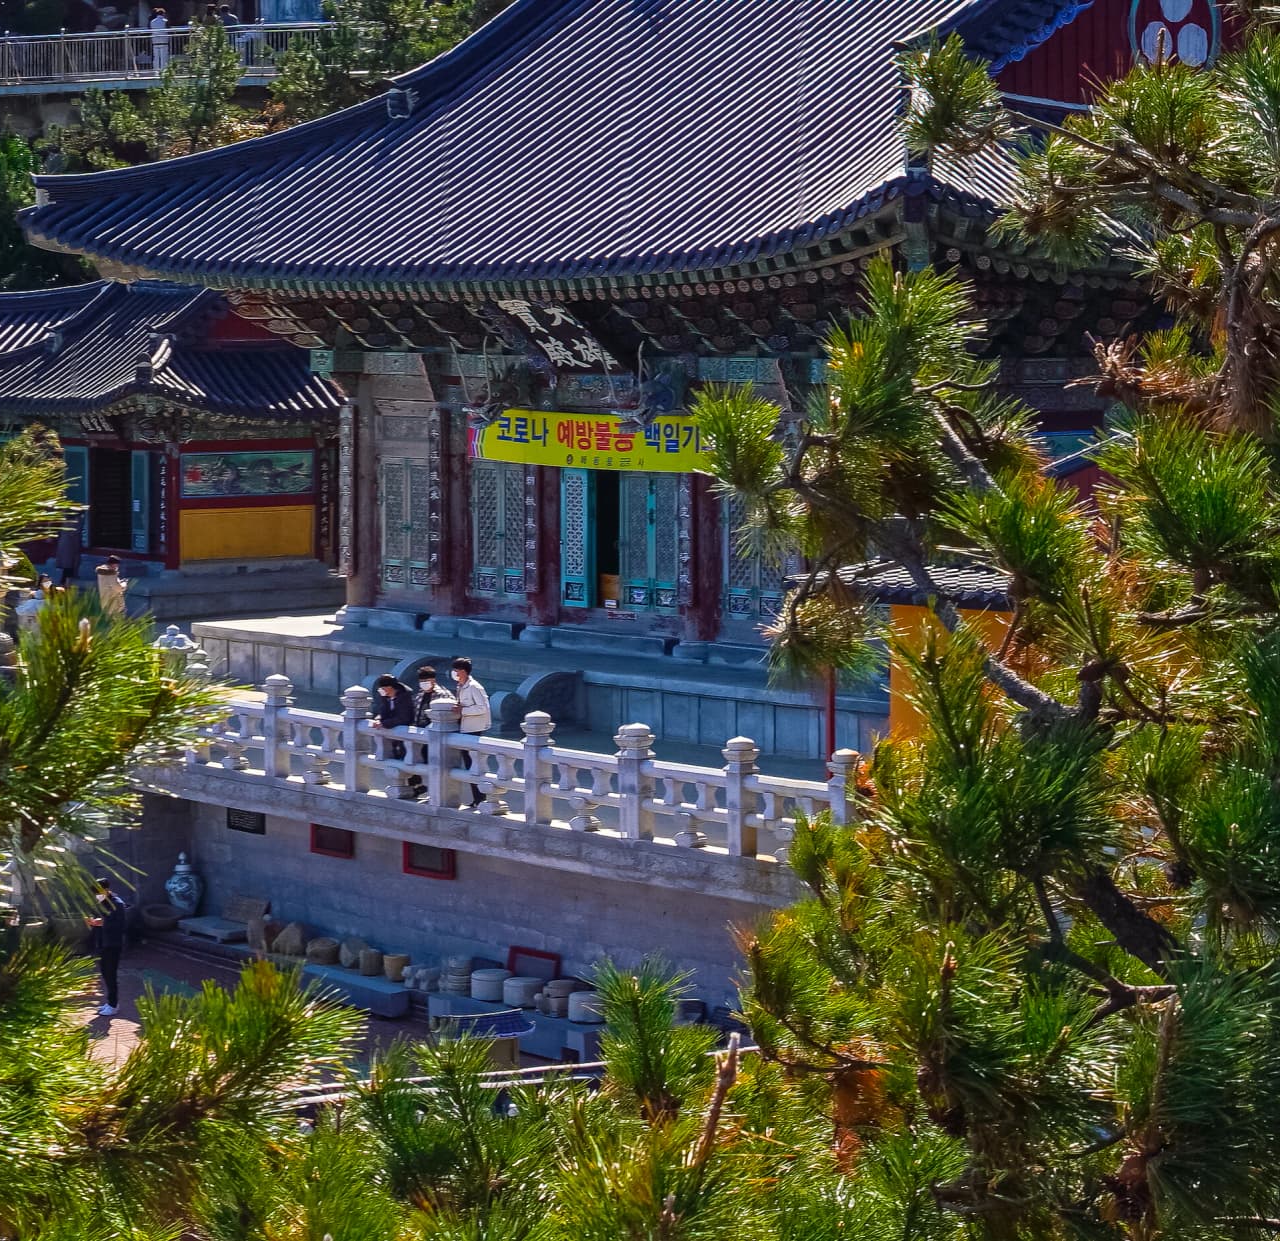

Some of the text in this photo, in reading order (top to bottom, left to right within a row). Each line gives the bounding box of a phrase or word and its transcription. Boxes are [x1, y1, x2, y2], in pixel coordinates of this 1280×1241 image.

[496, 416, 713, 454] 코로나 예방불공 백일기
